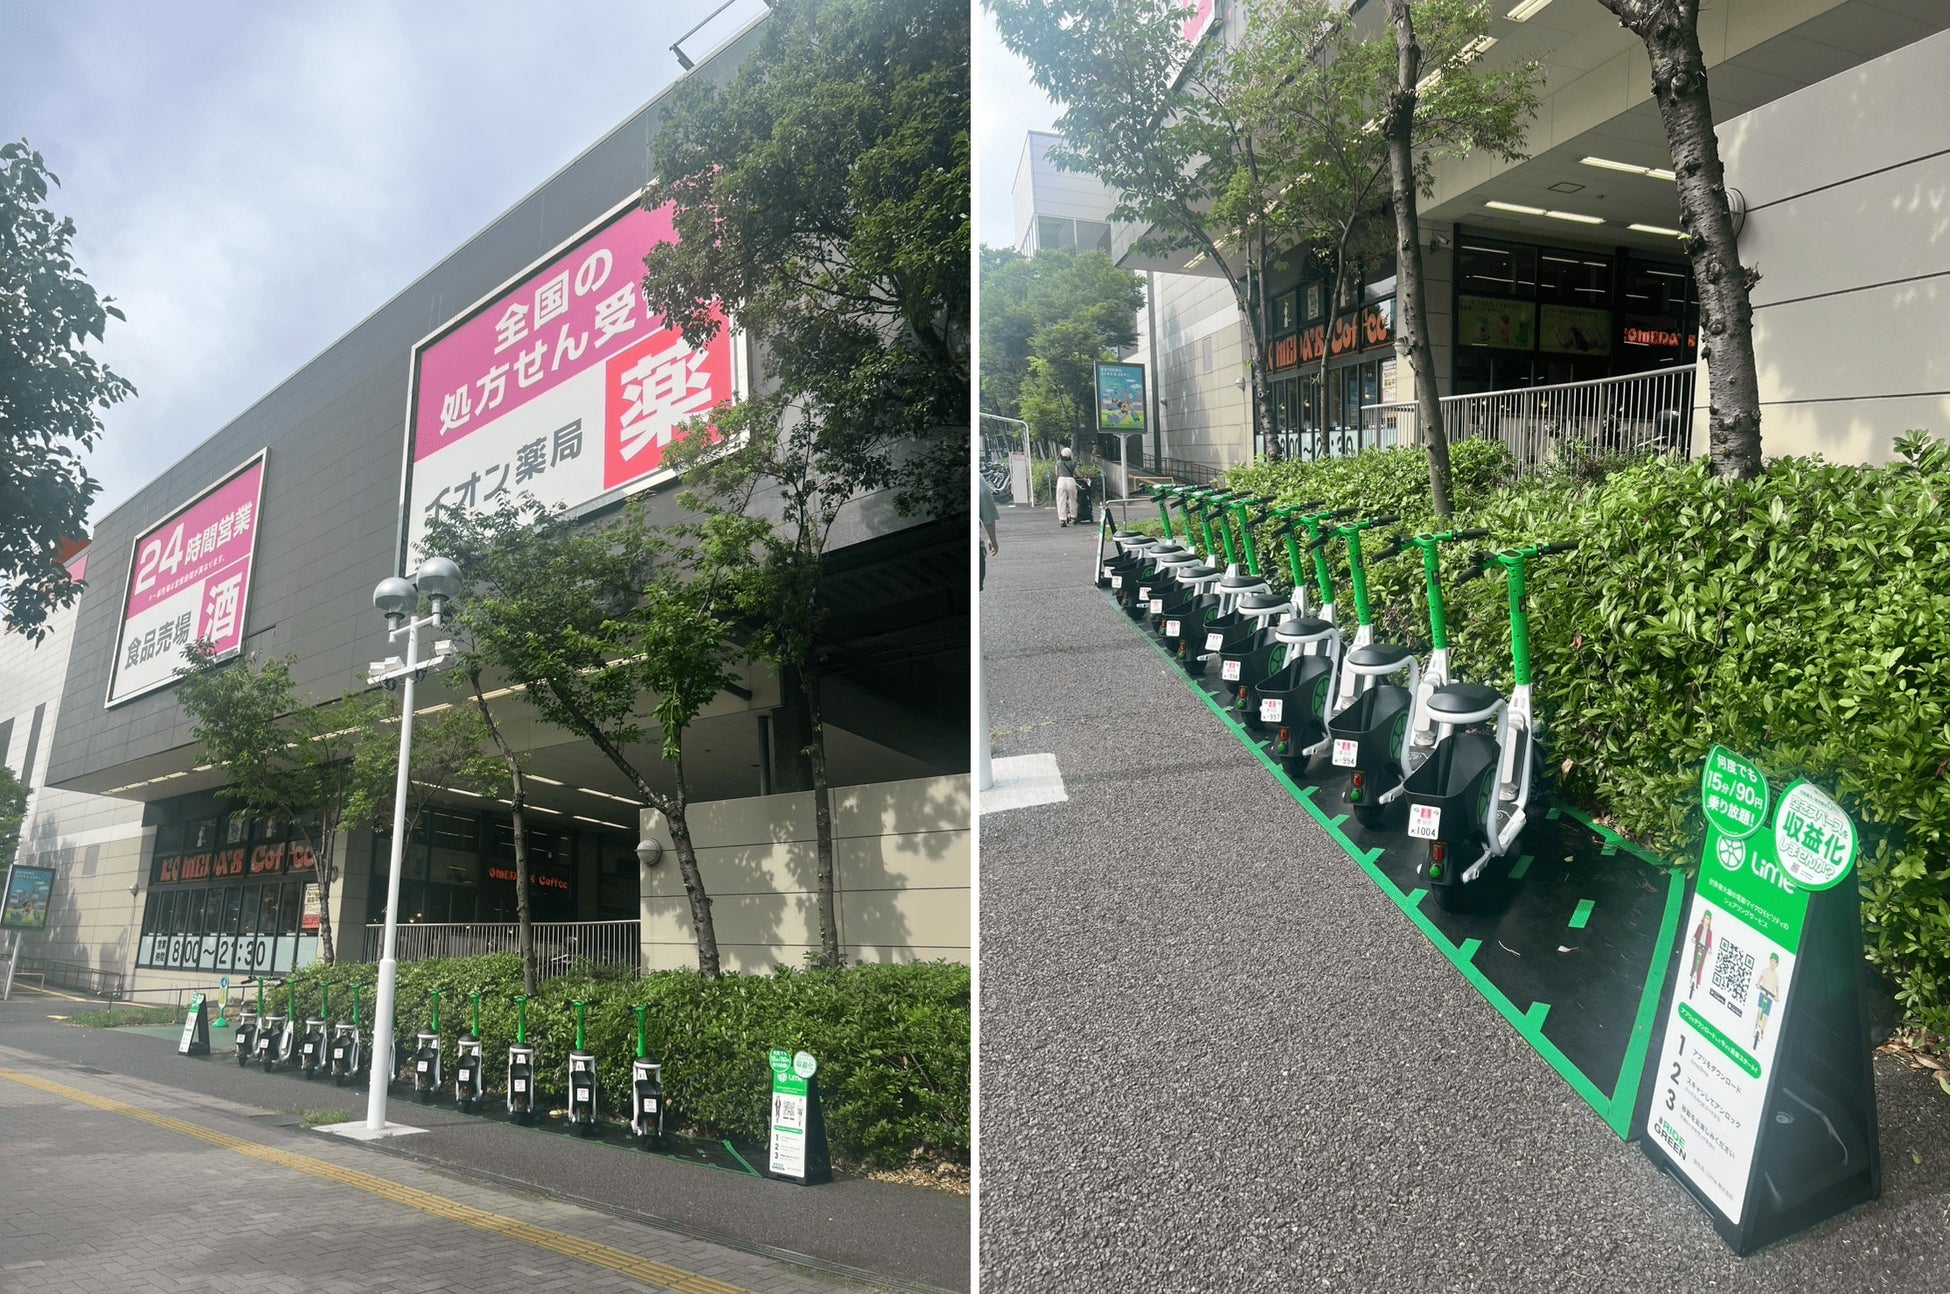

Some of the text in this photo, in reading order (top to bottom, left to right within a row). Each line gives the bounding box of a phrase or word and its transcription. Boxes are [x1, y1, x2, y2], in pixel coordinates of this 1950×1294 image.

[494, 249, 613, 355] 全国の
[439, 281, 656, 436] 処方せん受
[620, 337, 714, 462] 薬
[205, 572, 243, 643] 酒
[125, 610, 192, 671] 食品売場
[1717, 754, 1758, 783] 何度でも
[1783, 810, 1846, 866] 収益化
[1751, 851, 1797, 894] Lime
[1679, 1034, 1686, 1056] 1
[1670, 1061, 1682, 1085] 2
[1665, 1088, 1676, 1111] 3
[1654, 1122, 1687, 1161] GREEN
